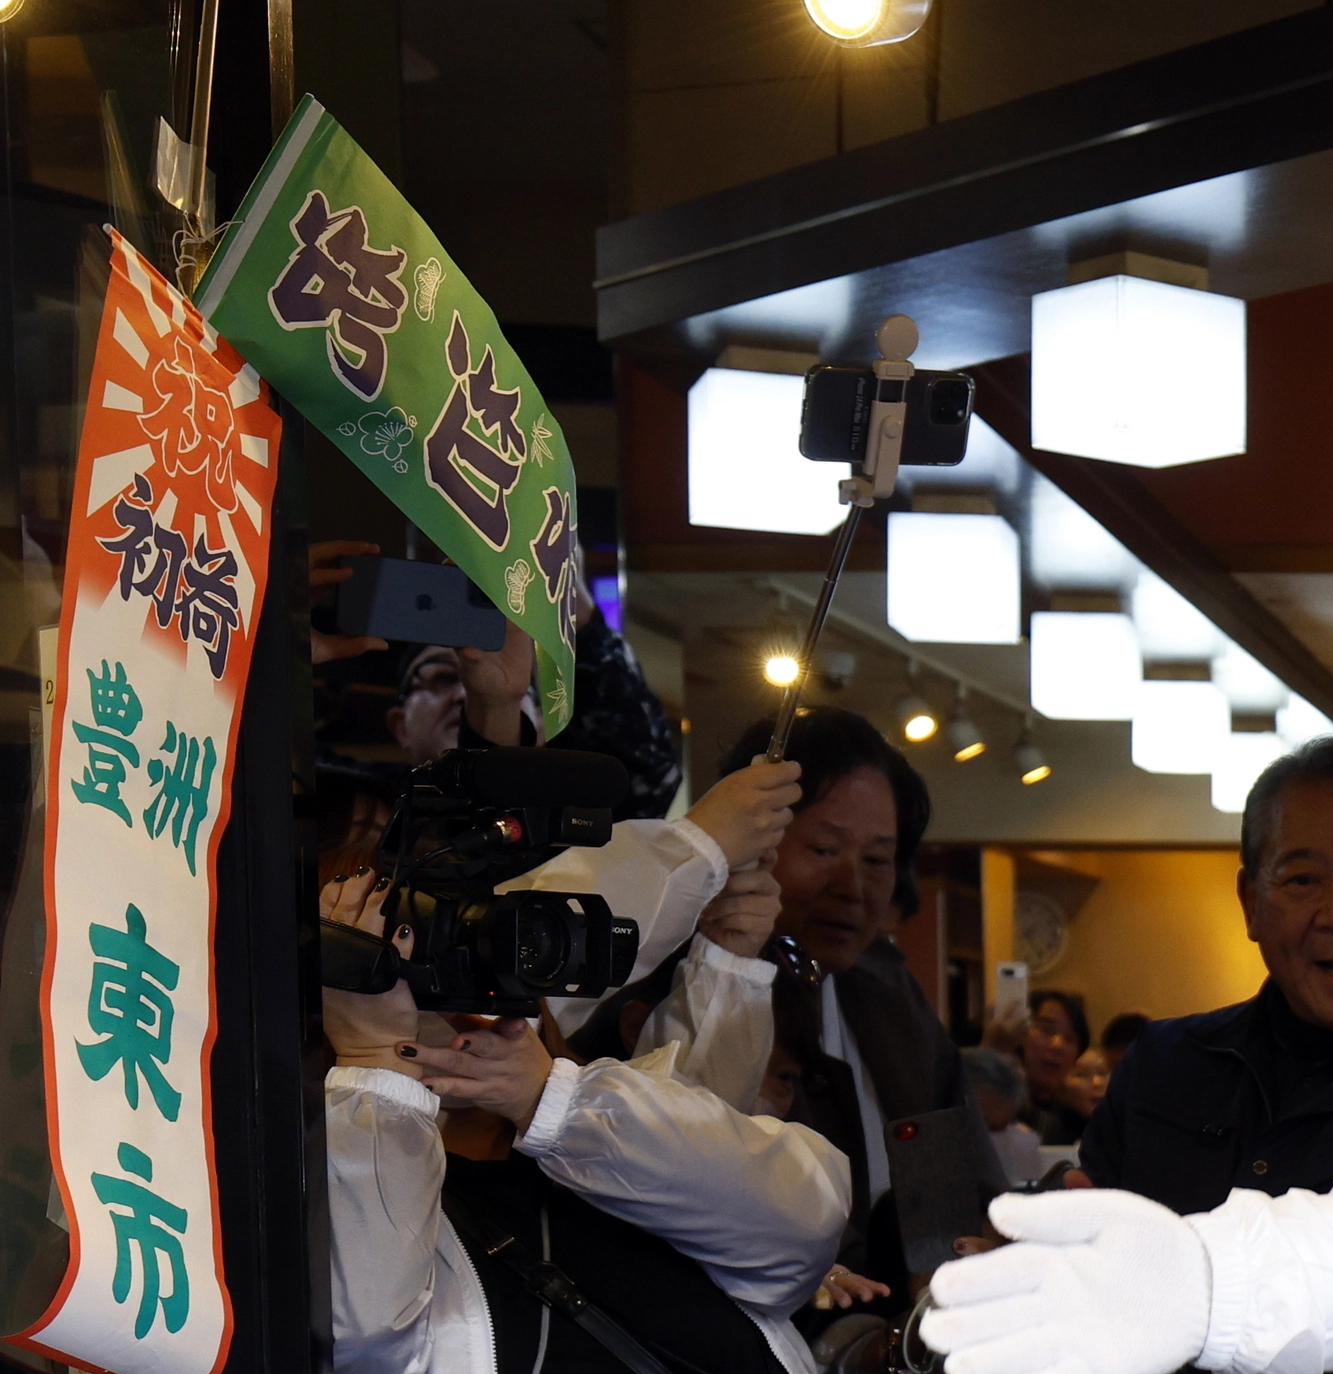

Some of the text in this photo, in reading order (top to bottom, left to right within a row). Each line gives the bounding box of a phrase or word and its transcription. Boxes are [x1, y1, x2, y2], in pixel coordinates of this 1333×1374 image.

[137, 334, 238, 515] 祝
[97, 472, 242, 681] 初荷
[70, 657, 218, 877] 豊洲
[571, 817, 594, 827] SONY
